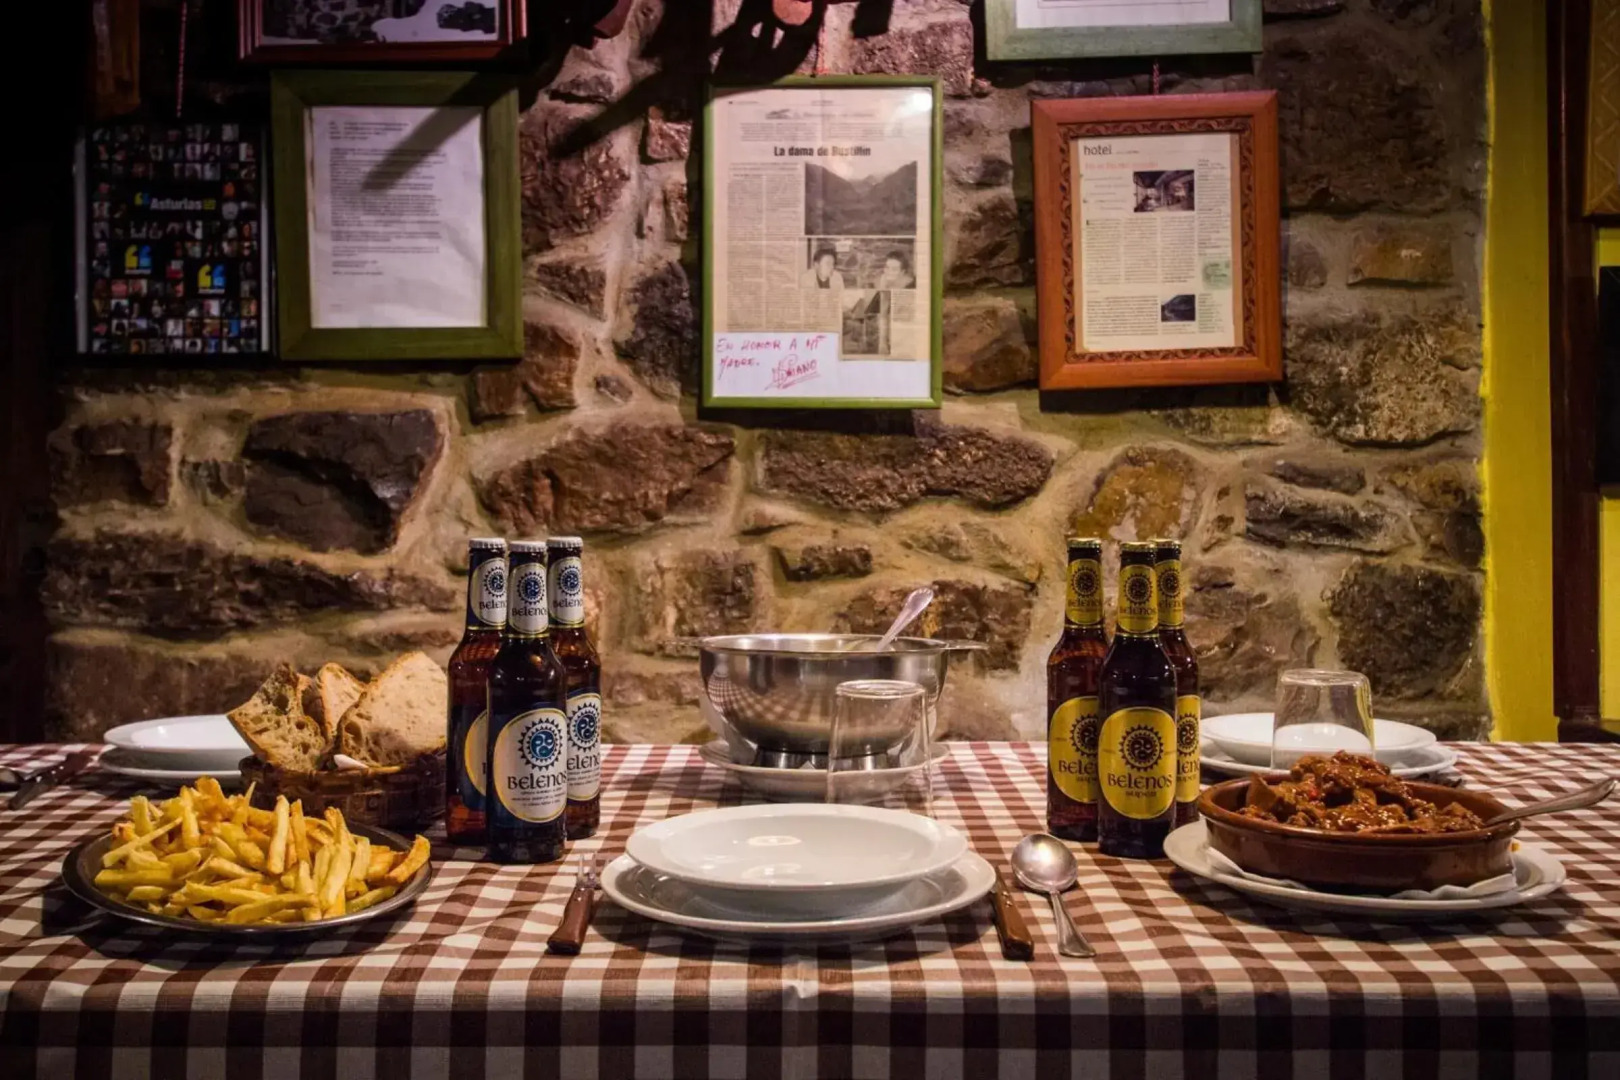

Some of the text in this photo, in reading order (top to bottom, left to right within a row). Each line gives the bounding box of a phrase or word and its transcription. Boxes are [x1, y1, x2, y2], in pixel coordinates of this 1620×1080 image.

[774, 146, 785, 157] La
[788, 146, 814, 157] dama
[817, 146, 829, 157] de
[1083, 145, 1112, 156] hotel
[150, 197, 202, 210] Asturias
[789, 338, 797, 350] A
